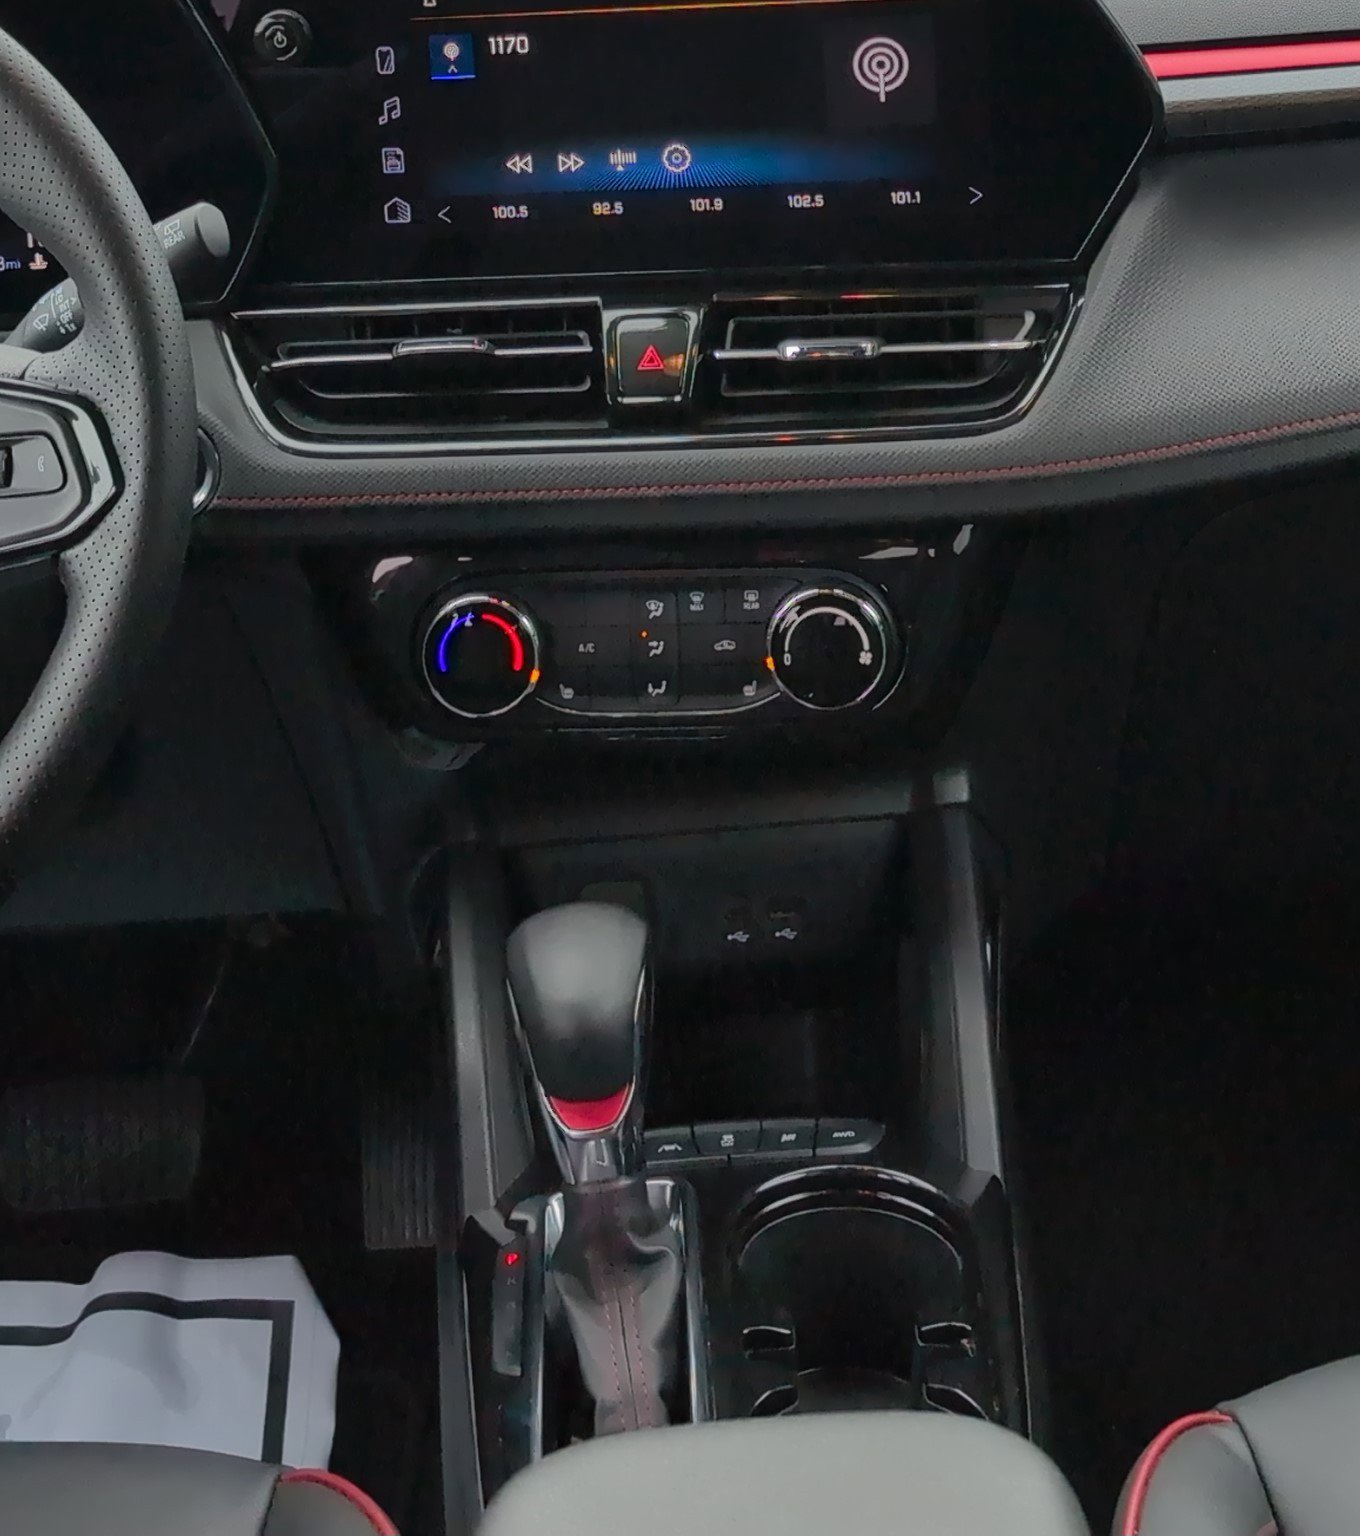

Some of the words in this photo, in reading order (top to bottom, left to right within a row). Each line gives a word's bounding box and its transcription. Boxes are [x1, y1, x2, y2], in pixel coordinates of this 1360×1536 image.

[488, 36, 530, 55] 1170
[492, 205, 529, 219] 100.5
[592, 201, 624, 215] 92.5
[689, 197, 724, 213] 101.9
[786, 193, 825, 209] 102.5
[890, 190, 921, 205] 101.1
[163, 231, 186, 249] REAR
[578, 642, 595, 653] A/C
